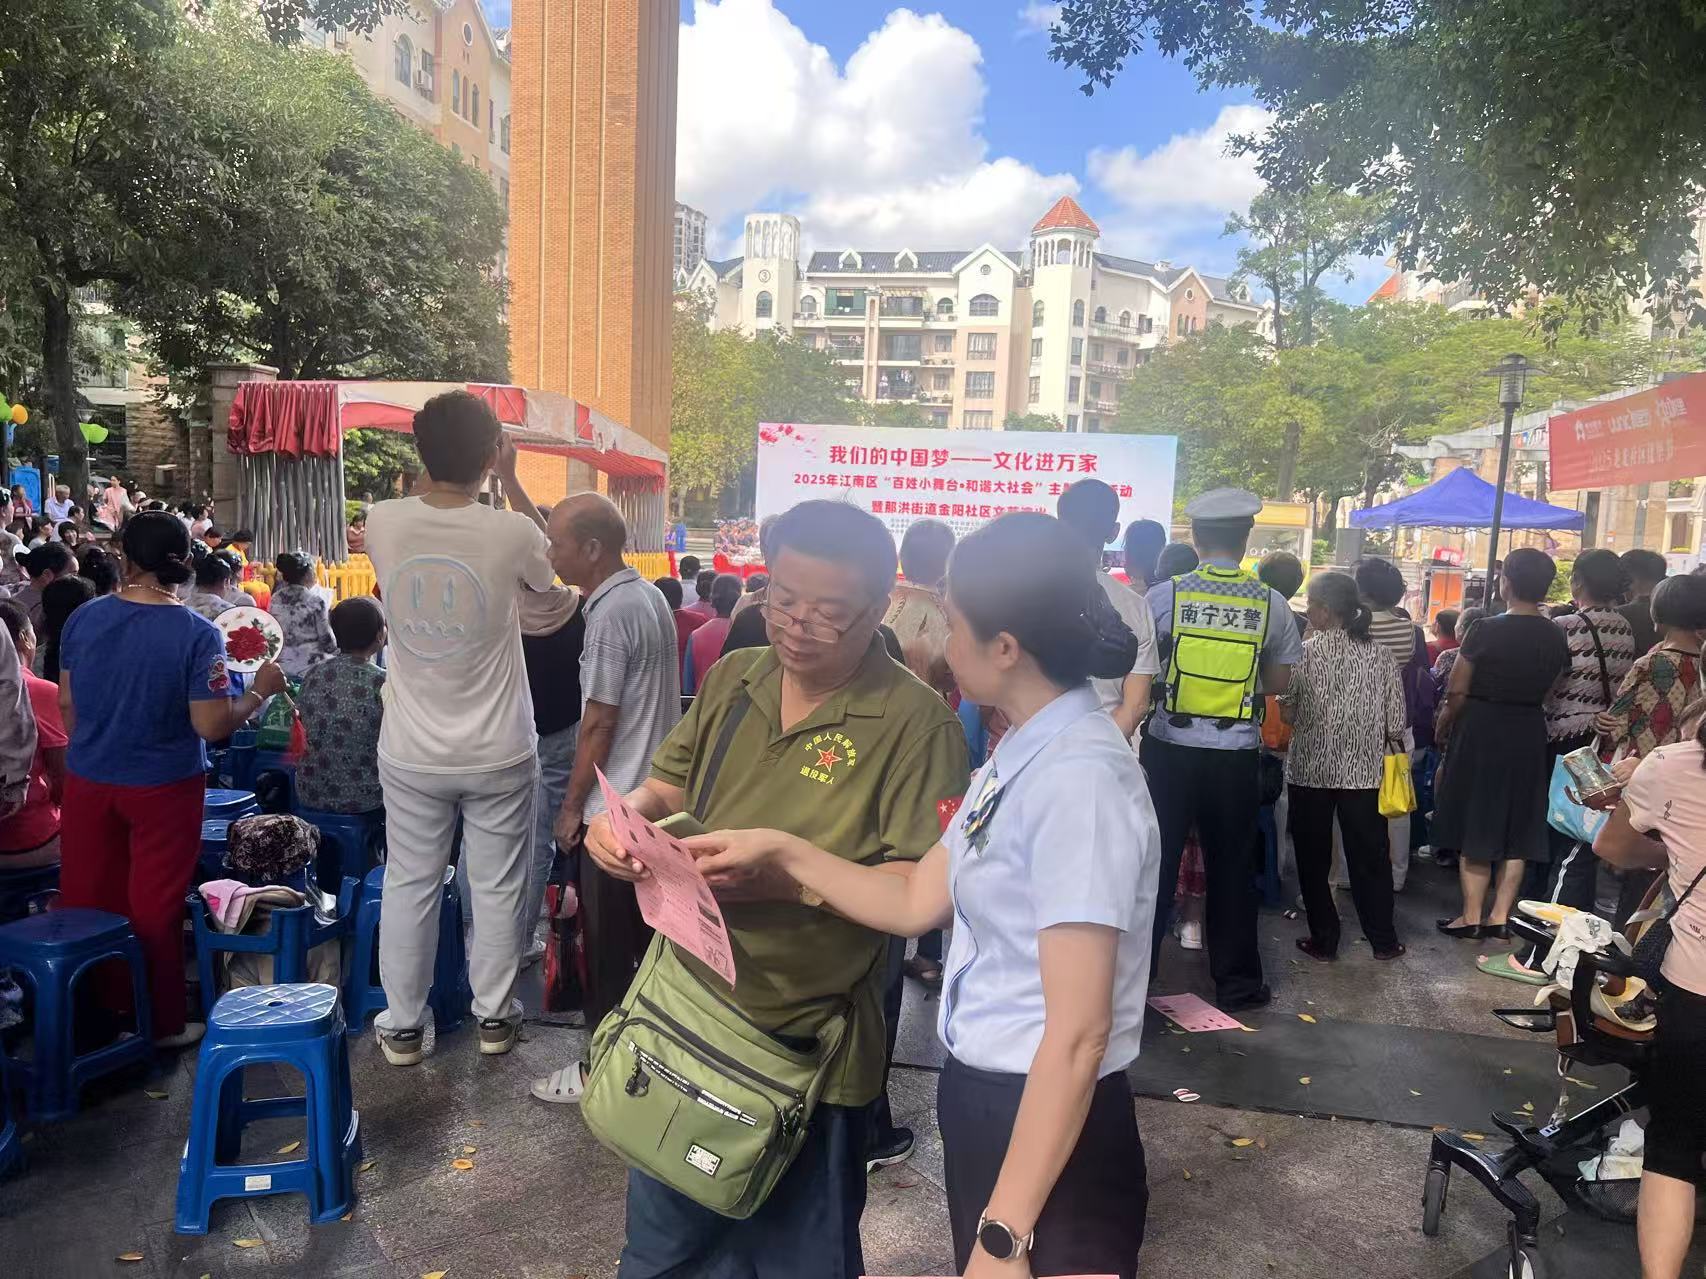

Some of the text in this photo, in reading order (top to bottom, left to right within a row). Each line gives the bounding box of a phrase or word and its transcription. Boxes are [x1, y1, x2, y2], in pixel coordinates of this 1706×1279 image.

[829, 445, 1098, 473] 我们的中国梦——文化进万家
[794, 473, 1133, 498] 2025年江南区“百姓小舞台·和谐大社会”主动
[1181, 603, 1262, 631] 南宁交警
[804, 732, 857, 767] 中国人民解放军
[800, 765, 835, 785] 退役军人
